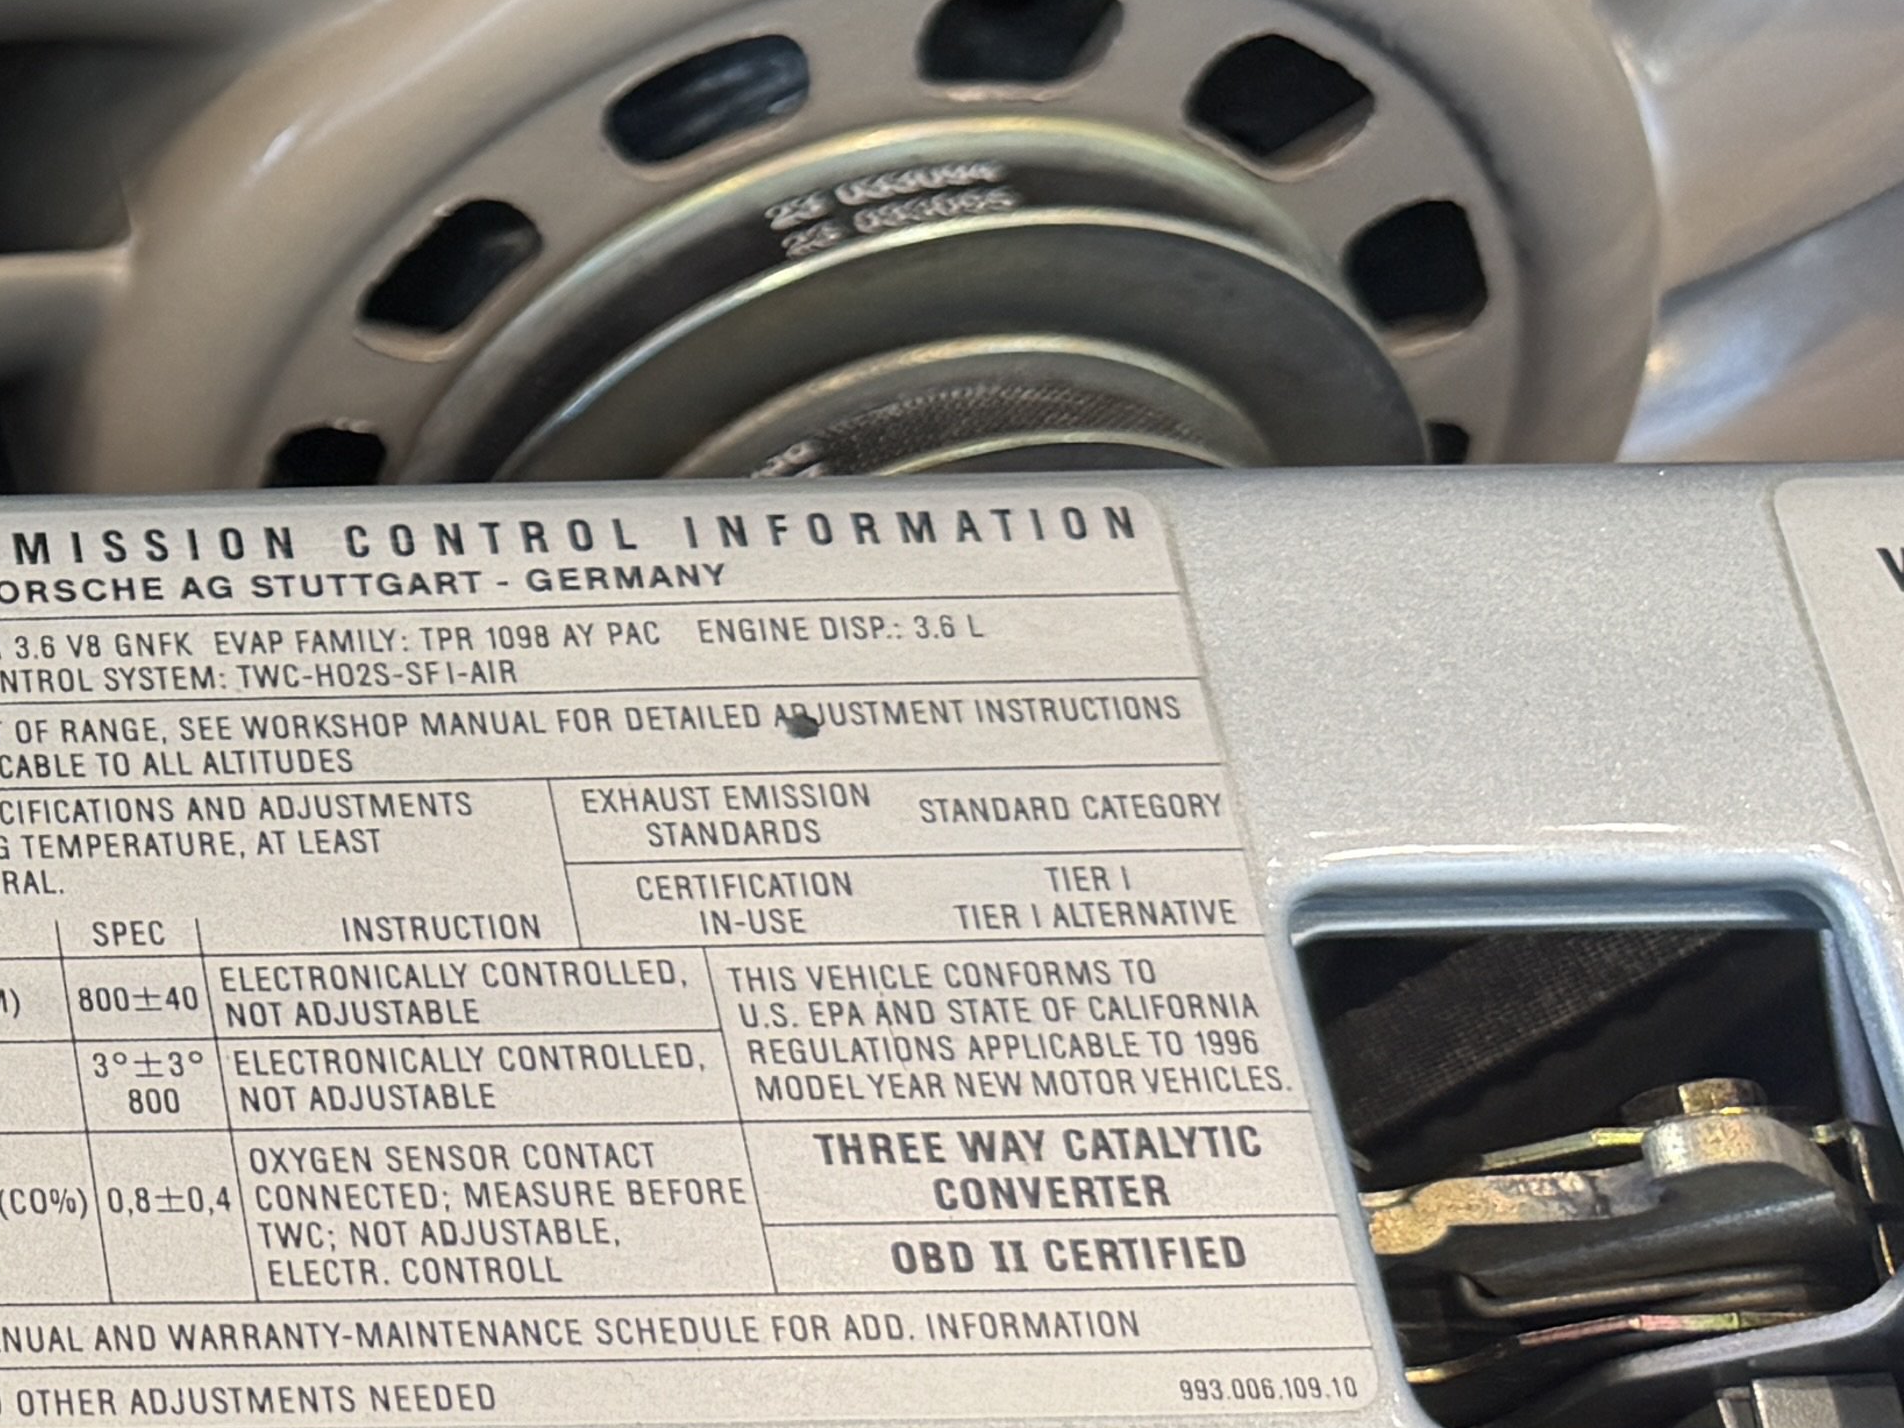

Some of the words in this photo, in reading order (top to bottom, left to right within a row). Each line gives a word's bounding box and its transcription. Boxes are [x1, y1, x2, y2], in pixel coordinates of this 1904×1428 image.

[344, 517, 638, 558] CONTROL
[683, 505, 1135, 549] INFORMATION
[179, 574, 233, 600] AG
[250, 569, 482, 599] STUTTGART
[525, 562, 724, 593] GERMANY
[13, 634, 56, 660] 3.6
[65, 633, 102, 658] V8
[113, 630, 193, 658] GNFK
[212, 629, 284, 656] EVAP
[294, 627, 409, 654] FAMILY:
[418, 625, 474, 651] TPR
[485, 624, 550, 650] 1098
[562, 622, 594, 648] AY
[605, 619, 660, 645] PAC
[696, 616, 810, 644] ENGINE
[818, 614, 902, 640] DISP.:
[912, 613, 956, 640] 3.6
[966, 614, 984, 638] L
[102, 664, 226, 692] SYSTEM:
[94, 751, 130, 777] TO
[142, 750, 193, 776] ALL
[202, 747, 354, 775] ALTITUDES
[186, 795, 246, 822] AND
[258, 790, 472, 820] ADJUSTMENTS
[579, 784, 711, 814] EXHAUST
[721, 781, 871, 811] EMISSION
[918, 795, 1071, 824] STANDARD
[1080, 792, 1221, 820] CATEGORY
[644, 817, 822, 848] STANDARDS
[91, 919, 165, 948] SPEC
[340, 912, 541, 943] INSTRUCTION
[811, 1130, 947, 1165] THREE
[955, 1128, 1045, 1163] WAY
[1061, 1124, 1262, 1162] CATALYTIC
[932, 1173, 1171, 1211] CONVERTER
[890, 1240, 975, 1275] OBD
[988, 1239, 1029, 1273] II
[1042, 1234, 1247, 1272] CERTIFIED
[15, 1387, 117, 1417] OTHER
[129, 1384, 356, 1416] ADJUSTMENTS
[368, 1382, 496, 1412] NEEDED
[1178, 1375, 1359, 1401] 993.006.109.10
